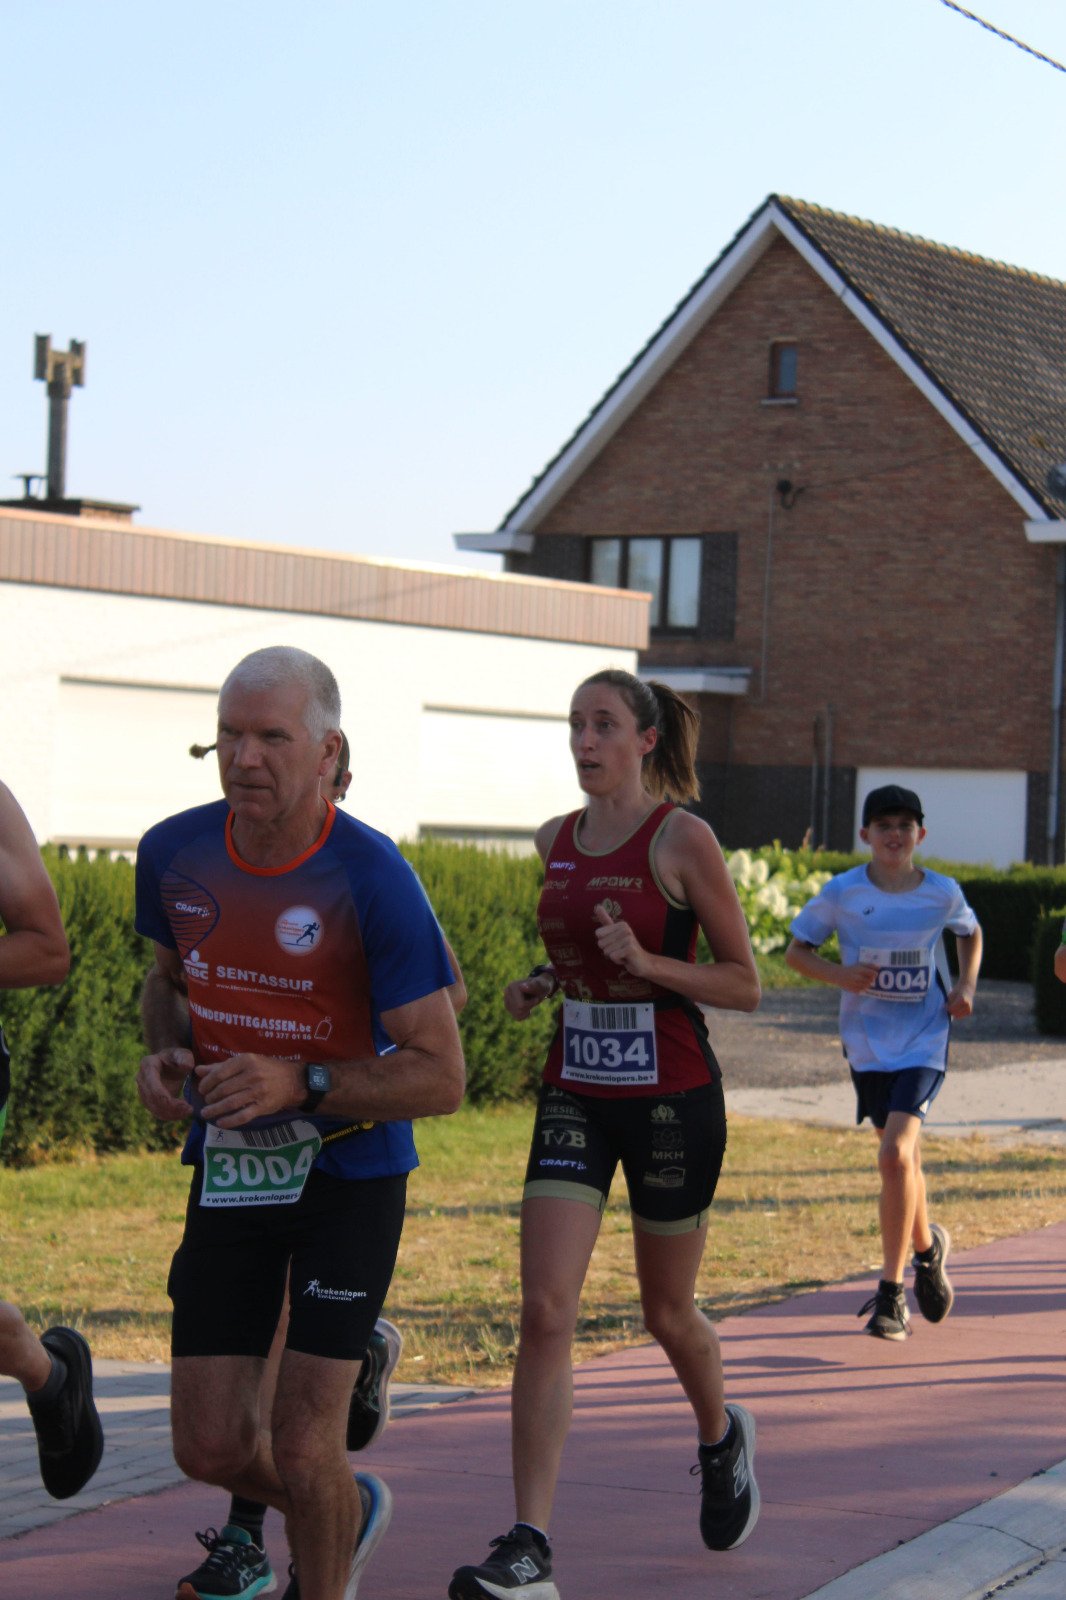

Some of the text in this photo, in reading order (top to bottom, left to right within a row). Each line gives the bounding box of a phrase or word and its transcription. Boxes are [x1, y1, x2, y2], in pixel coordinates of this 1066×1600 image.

[175, 902, 203, 915] CRAFT
[216, 965, 314, 992] SENTASSUR
[569, 1034, 649, 1068] 1034
[569, 1071, 648, 1083] www.krekenlopers.be
[652, 1150, 684, 1160] MKH
[212, 1145, 313, 1187] 3004
[539, 1158, 577, 1168] CRAFT
[316, 1286, 367, 1299] krekenlopers
